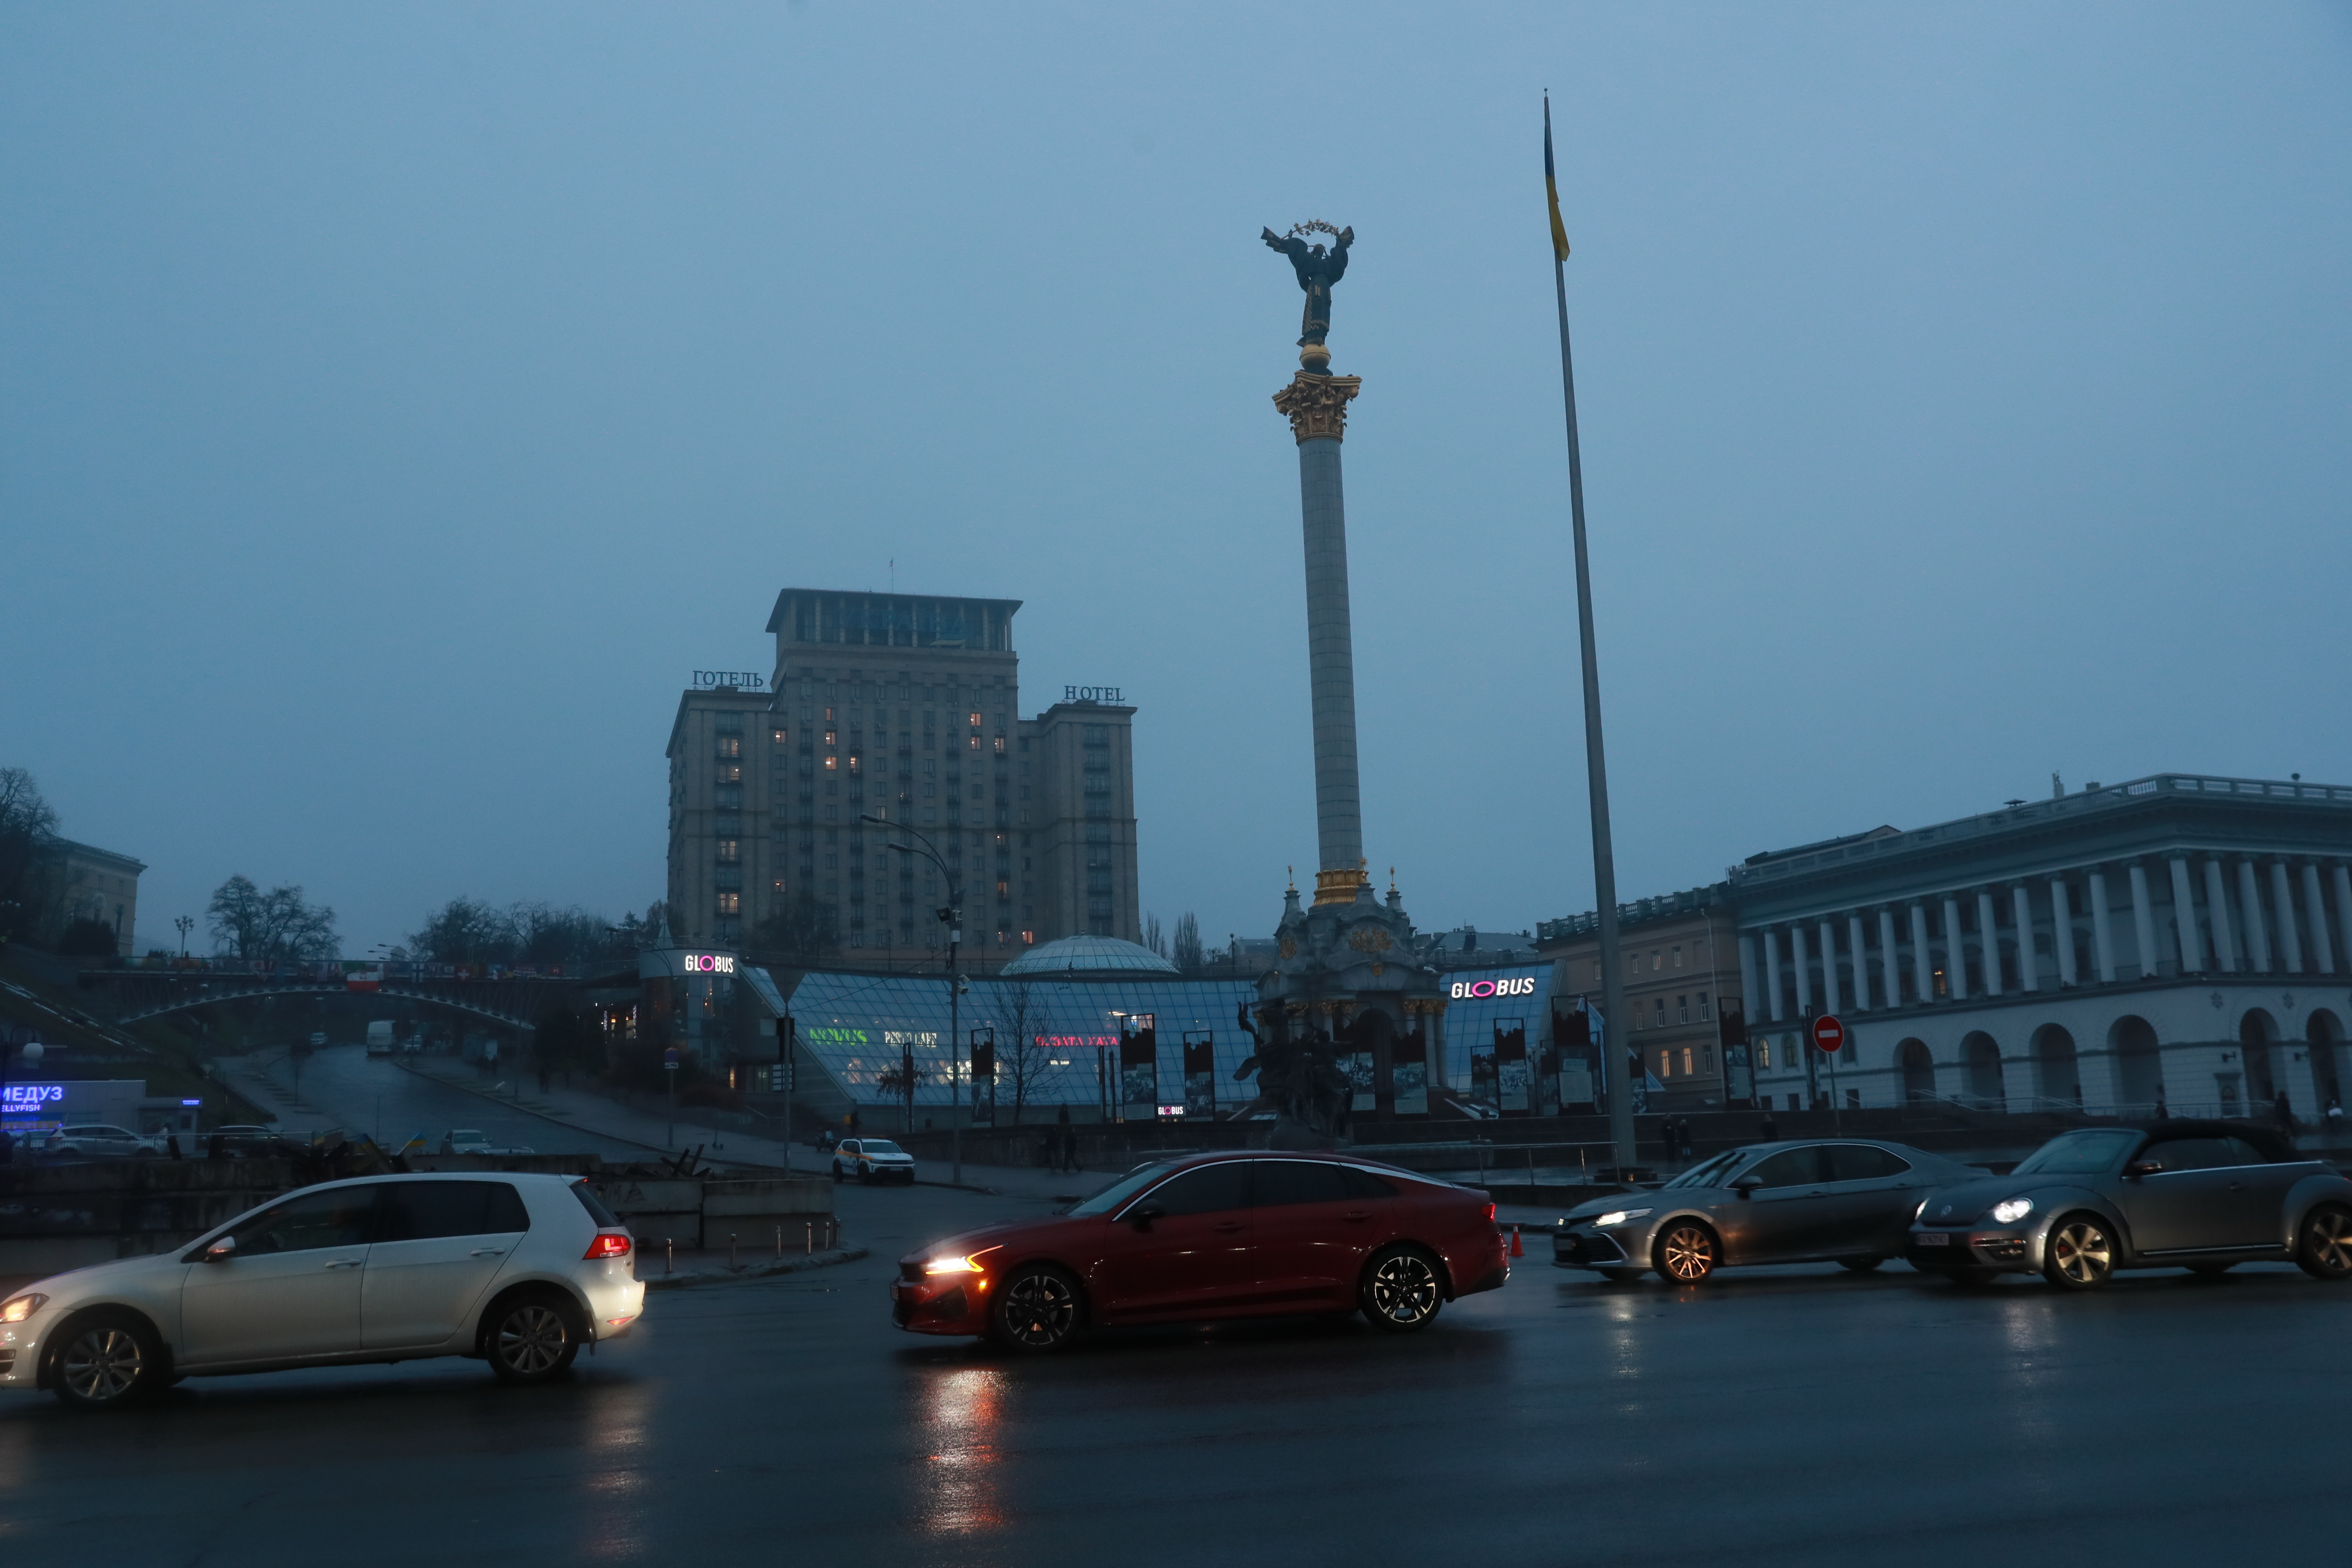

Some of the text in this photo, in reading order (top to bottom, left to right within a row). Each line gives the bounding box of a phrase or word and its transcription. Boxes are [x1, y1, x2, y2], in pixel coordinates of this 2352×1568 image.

[692, 671, 764, 687] ГОТЕЛЬ
[1064, 686, 1126, 701] HOTEL
[685, 955, 734, 974] GLOBUS
[1451, 977, 1535, 998] GLOBUS
[809, 1028, 867, 1046] NOVUS
[1035, 1036, 1084, 1046] ПЗАТА
[1158, 1106, 1183, 1115] GLOBUS
